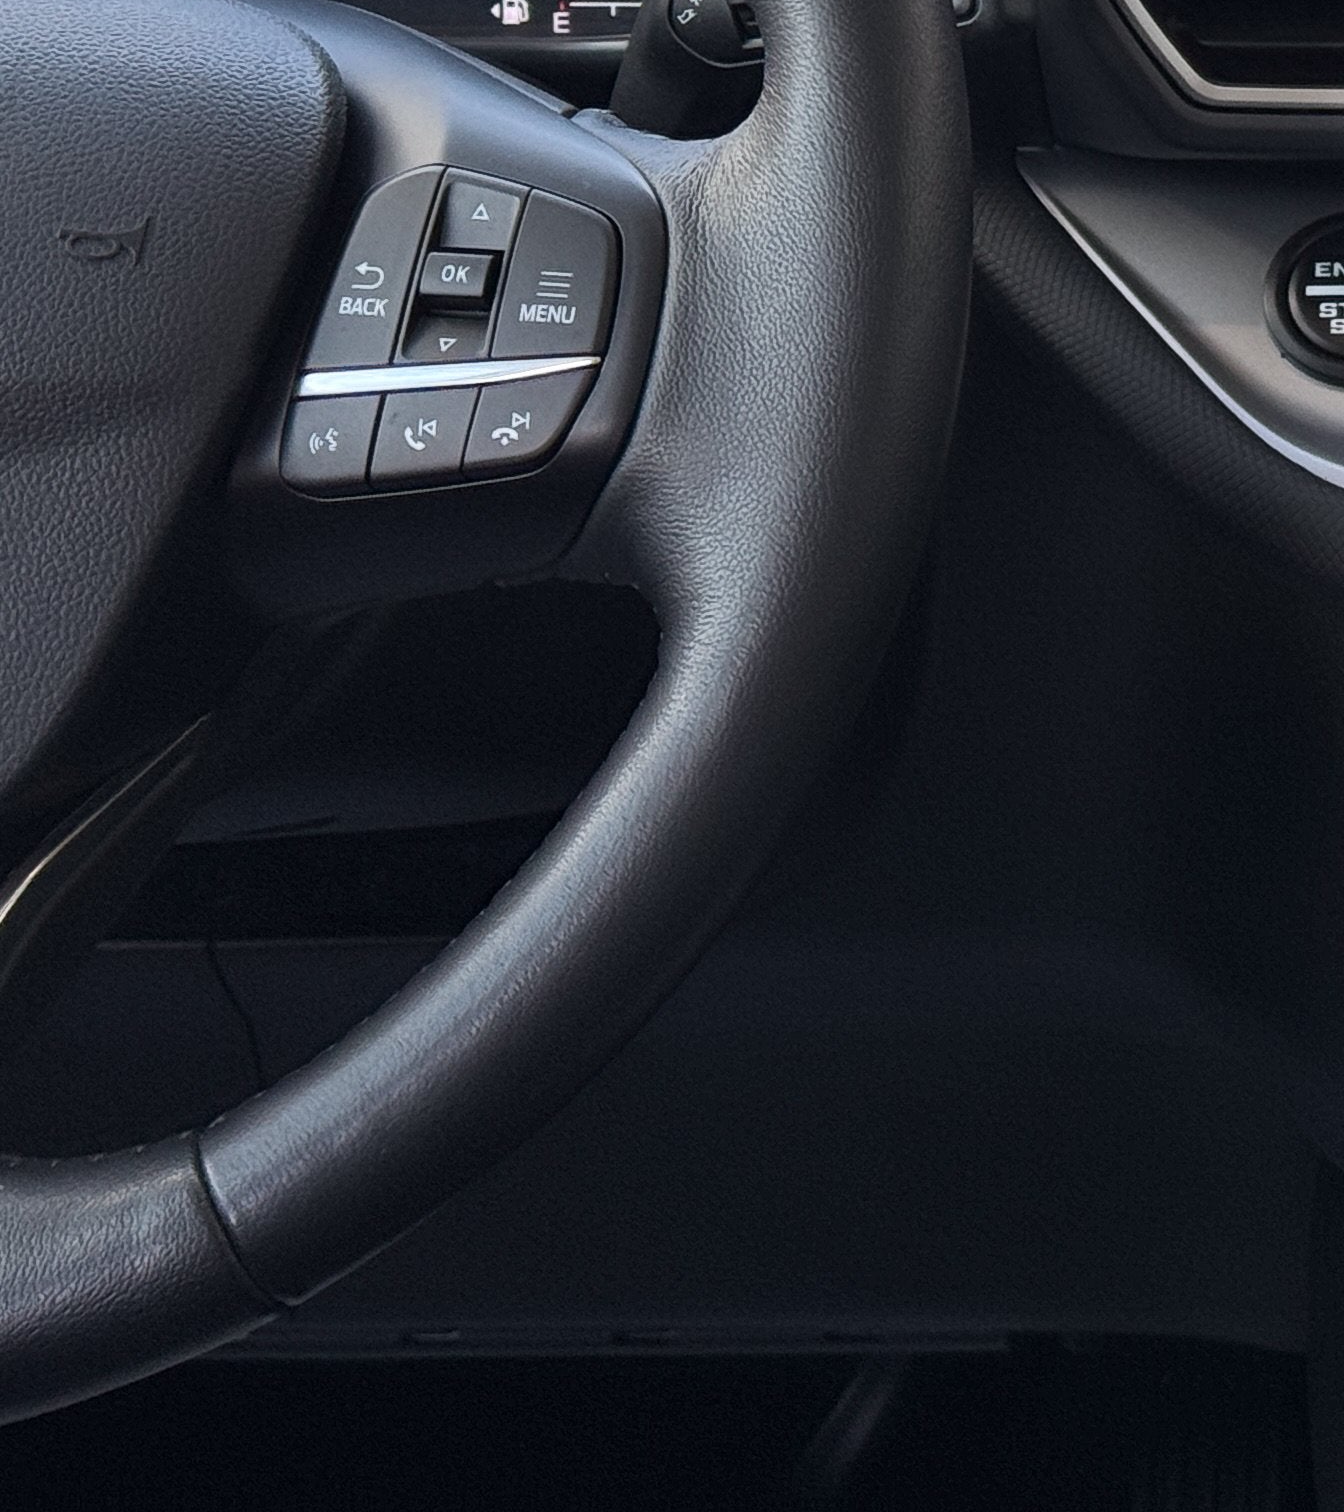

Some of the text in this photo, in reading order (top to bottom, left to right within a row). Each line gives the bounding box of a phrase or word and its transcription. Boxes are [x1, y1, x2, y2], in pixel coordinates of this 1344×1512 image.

[554, 13, 570, 33] E
[441, 265, 470, 283] OK
[338, 297, 387, 317] BACK
[519, 303, 575, 324] MENU
